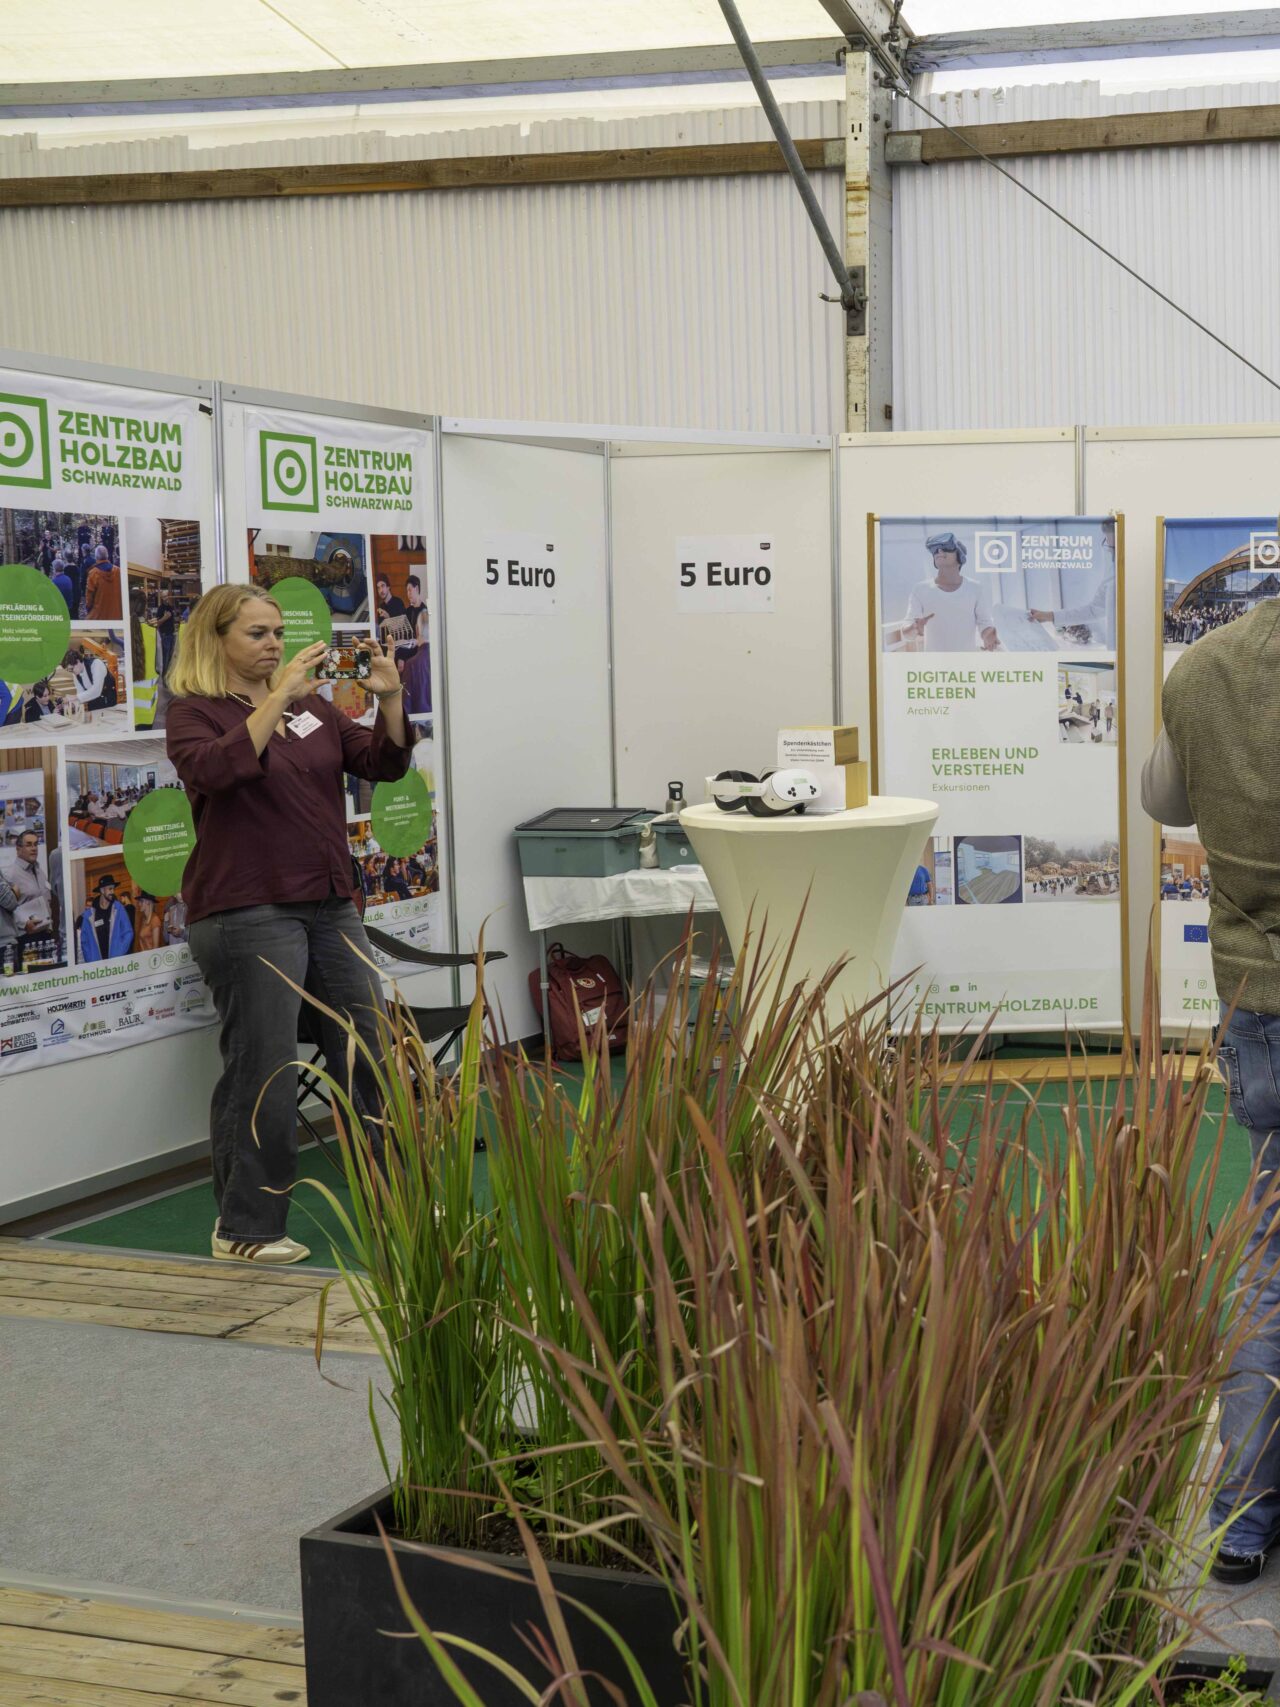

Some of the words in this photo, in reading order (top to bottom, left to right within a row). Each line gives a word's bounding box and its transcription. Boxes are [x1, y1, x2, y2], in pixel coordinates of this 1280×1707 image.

[58, 409, 182, 446] ZENTRUM
[59, 438, 182, 473] HOLZBAU
[323, 445, 412, 472] ZENTRUM
[61, 467, 182, 491] SCHWARZWALD
[324, 470, 412, 496] HOLZBAU
[326, 495, 413, 511] SCHWARZWALD
[1021, 535, 1093, 547] ZENTRUM
[1021, 548, 1093, 560] HOLZBAU
[1021, 561, 1093, 569] SCHWARZWALD
[486, 558, 499, 585] 5
[507, 559, 556, 588] Euro
[680, 562, 696, 587] 5
[707, 561, 771, 587] Euro
[0, 602, 38, 611] FKLÄRUNG
[0, 613, 64, 621] TSEINSFÖRDERUNG
[906, 671, 977, 683] DIGITALE
[980, 670, 1044, 683] WELTEN
[906, 687, 976, 700] ERLEBEN
[906, 705, 950, 716] ArchiViZ
[932, 748, 1000, 760] ERLEBEN
[1005, 747, 1039, 759] UND
[932, 763, 1025, 776] VERSTEHEN
[932, 783, 990, 792] Exkursionen
[0, 960, 140, 997] www.zentrum-holzbau.de
[914, 998, 1098, 1015] ZENTRUM-HOLZBAU.DE
